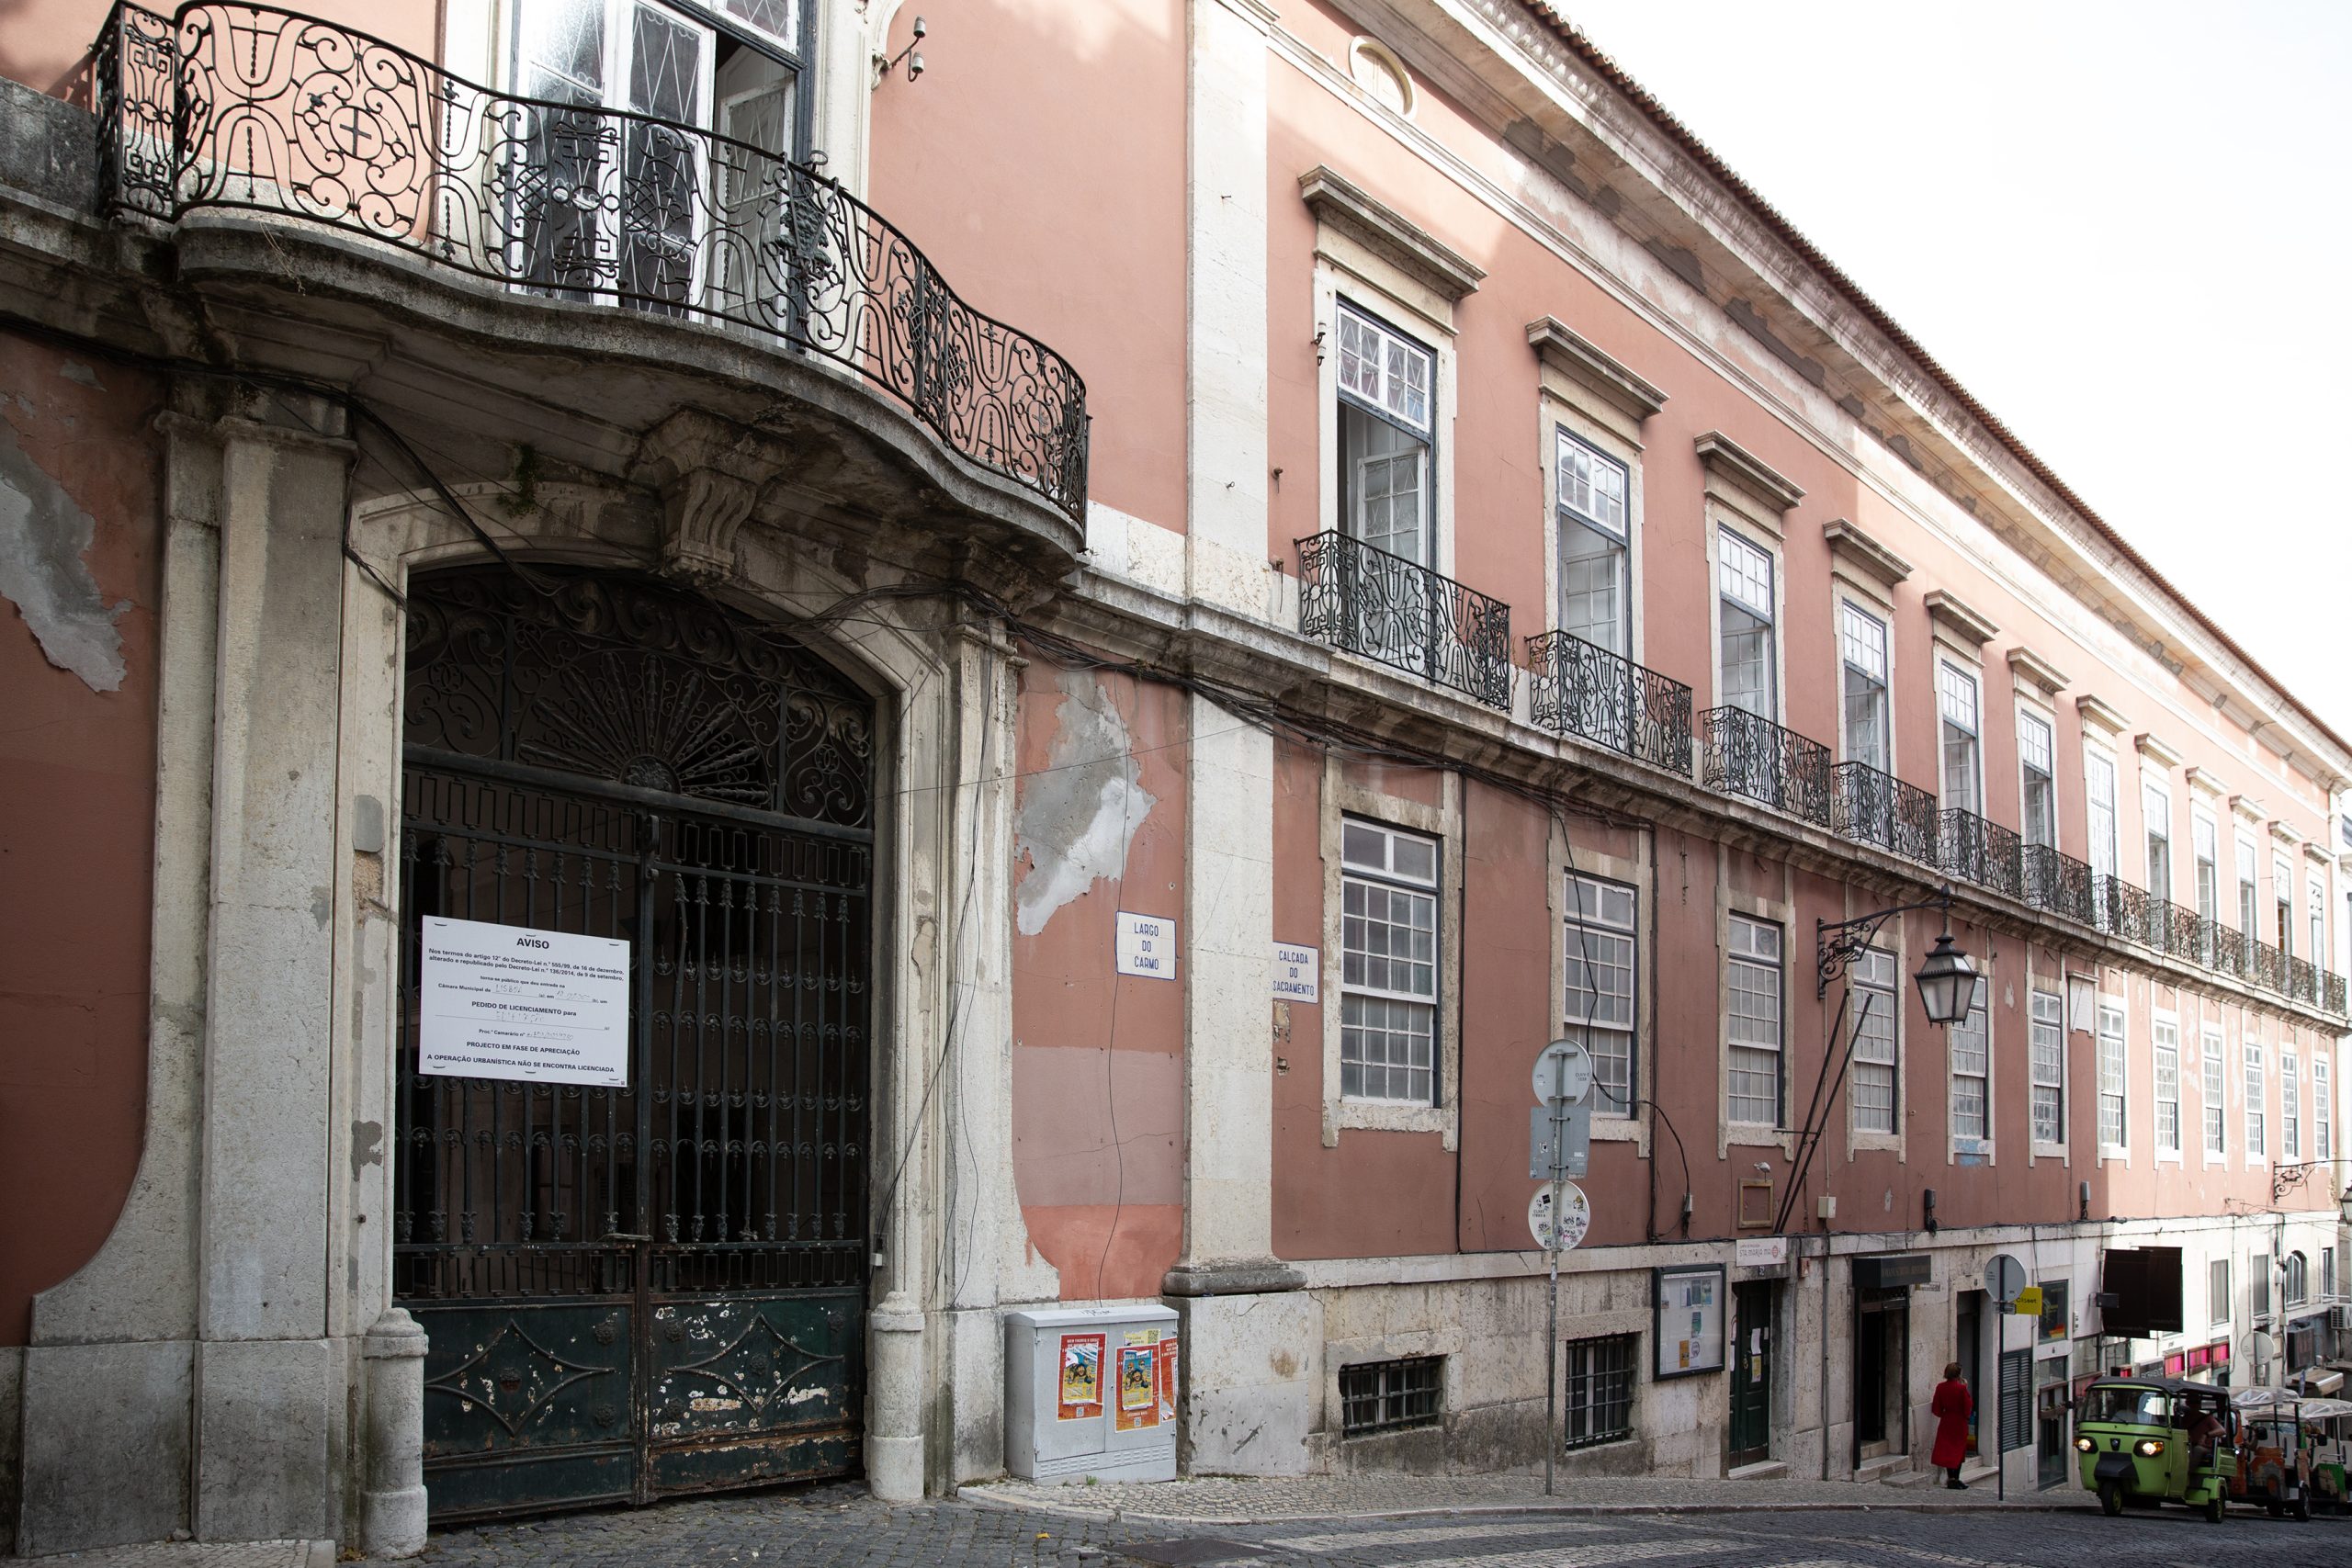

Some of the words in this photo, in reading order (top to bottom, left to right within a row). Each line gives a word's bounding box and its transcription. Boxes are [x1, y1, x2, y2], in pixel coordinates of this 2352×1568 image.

[1134, 922, 1159, 937] LARGO
[516, 938, 549, 950] AVISO
[1141, 941, 1152, 953] DO
[460, 959, 494, 967] republicado
[509, 964, 540, 972] Decreto-Lei
[511, 957, 542, 966] Decreto-Lei
[596, 967, 625, 976] dezembro,
[1134, 956, 1159, 970] CARMO
[1289, 967, 1298, 978] DO
[1273, 981, 1315, 996] SACRAMENTO
[509, 1005, 562, 1015] LICENCIAMENTO
[540, 1047, 581, 1055] APRECIAÇÃO
[473, 1057, 516, 1066] URBANÍSTICA
[542, 1062, 576, 1070] ENCONTRA
